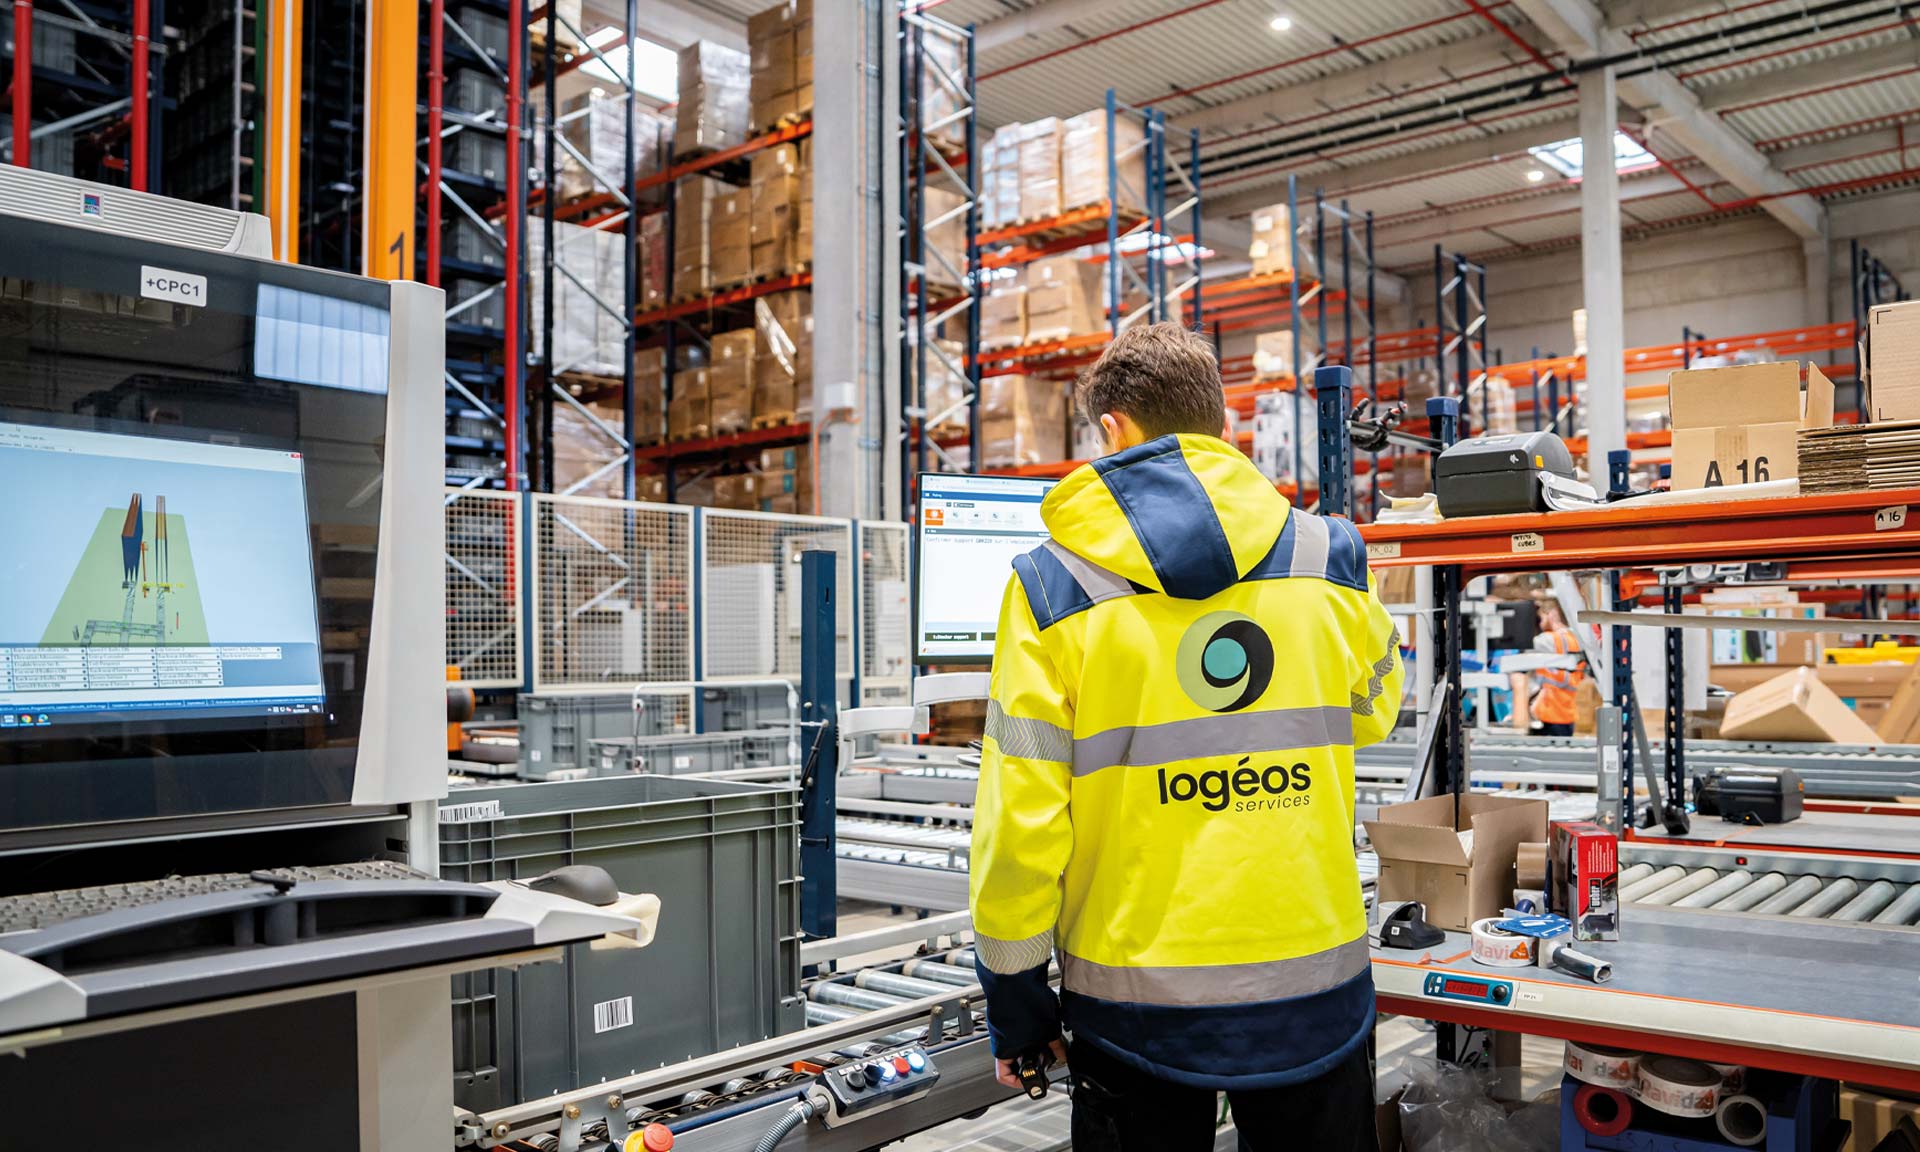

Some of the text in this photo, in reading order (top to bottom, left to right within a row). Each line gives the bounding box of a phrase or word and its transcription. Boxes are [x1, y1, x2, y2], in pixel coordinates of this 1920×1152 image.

[390, 231, 405, 280] 1
[146, 277, 199, 297] +CPC1
[1704, 456, 1770, 489] A 16
[1877, 512, 1902, 523] A 16
[1157, 756, 1311, 811] logéos
[1234, 794, 1311, 813] services
